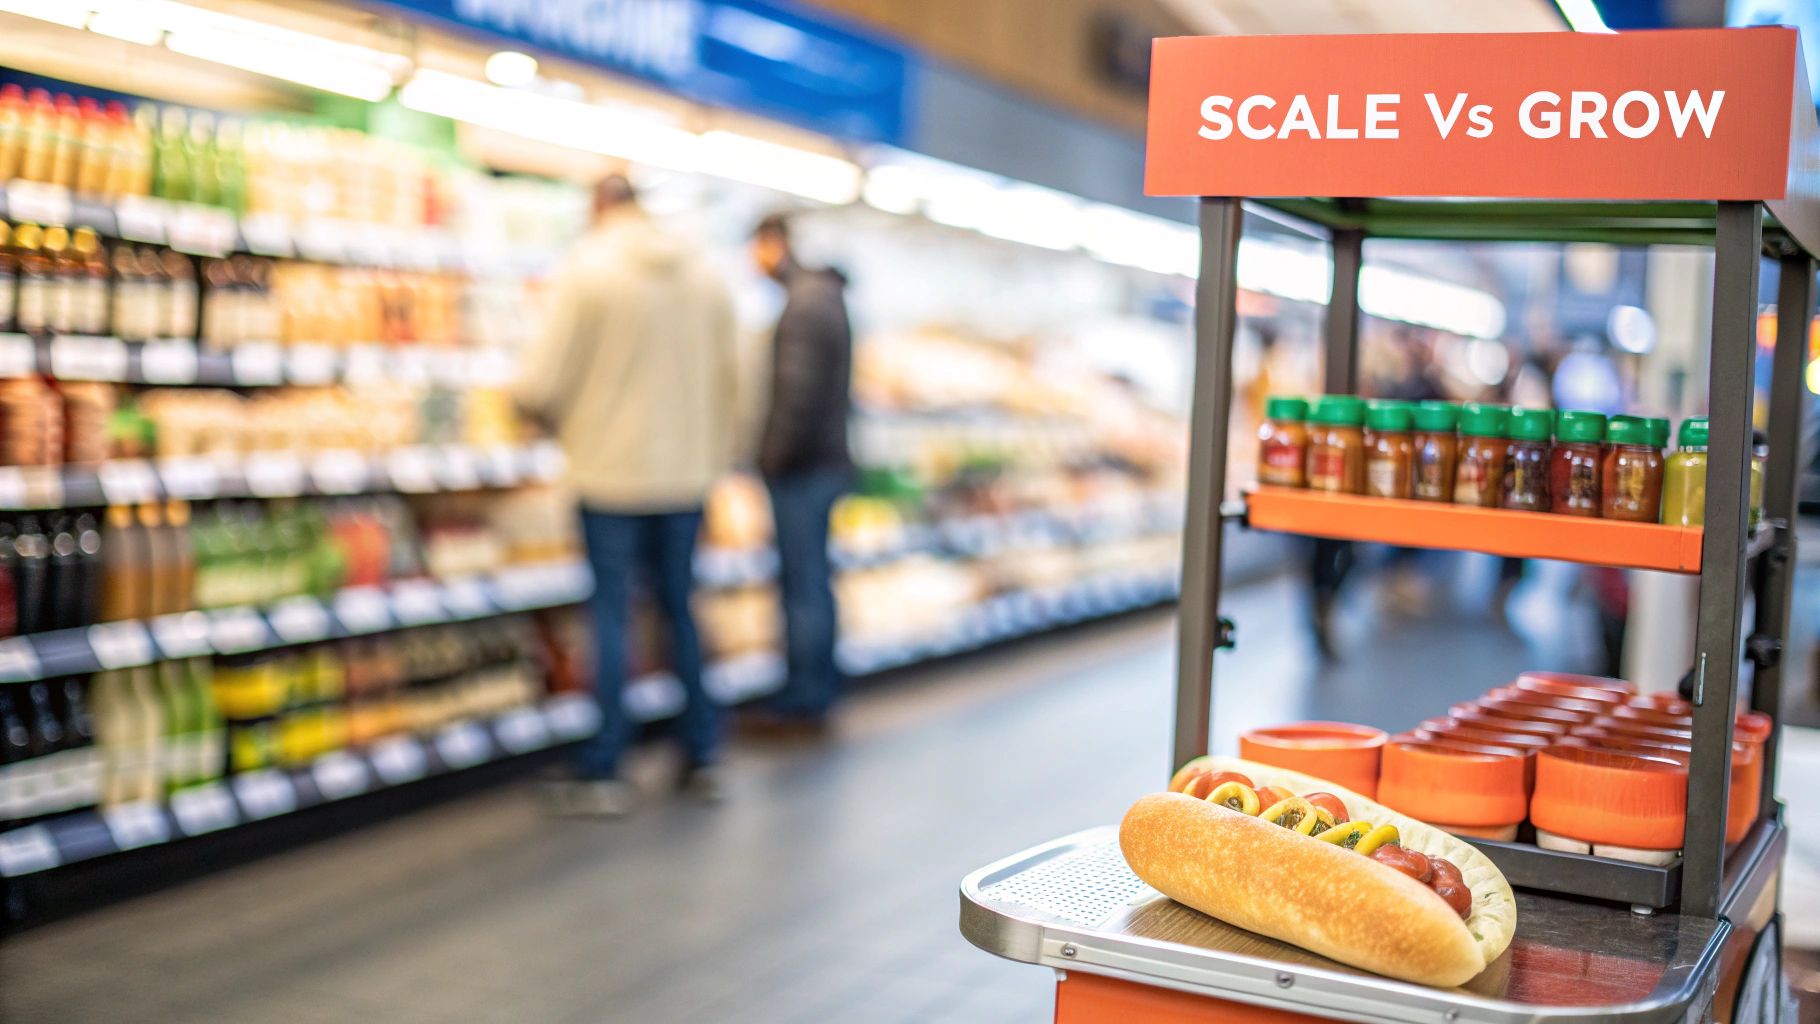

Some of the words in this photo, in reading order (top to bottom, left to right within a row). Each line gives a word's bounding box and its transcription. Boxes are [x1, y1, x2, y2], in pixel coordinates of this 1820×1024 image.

[1197, 94, 1401, 141] SCALE
[1424, 92, 1494, 140] Vs
[1518, 89, 1726, 139] GROW
